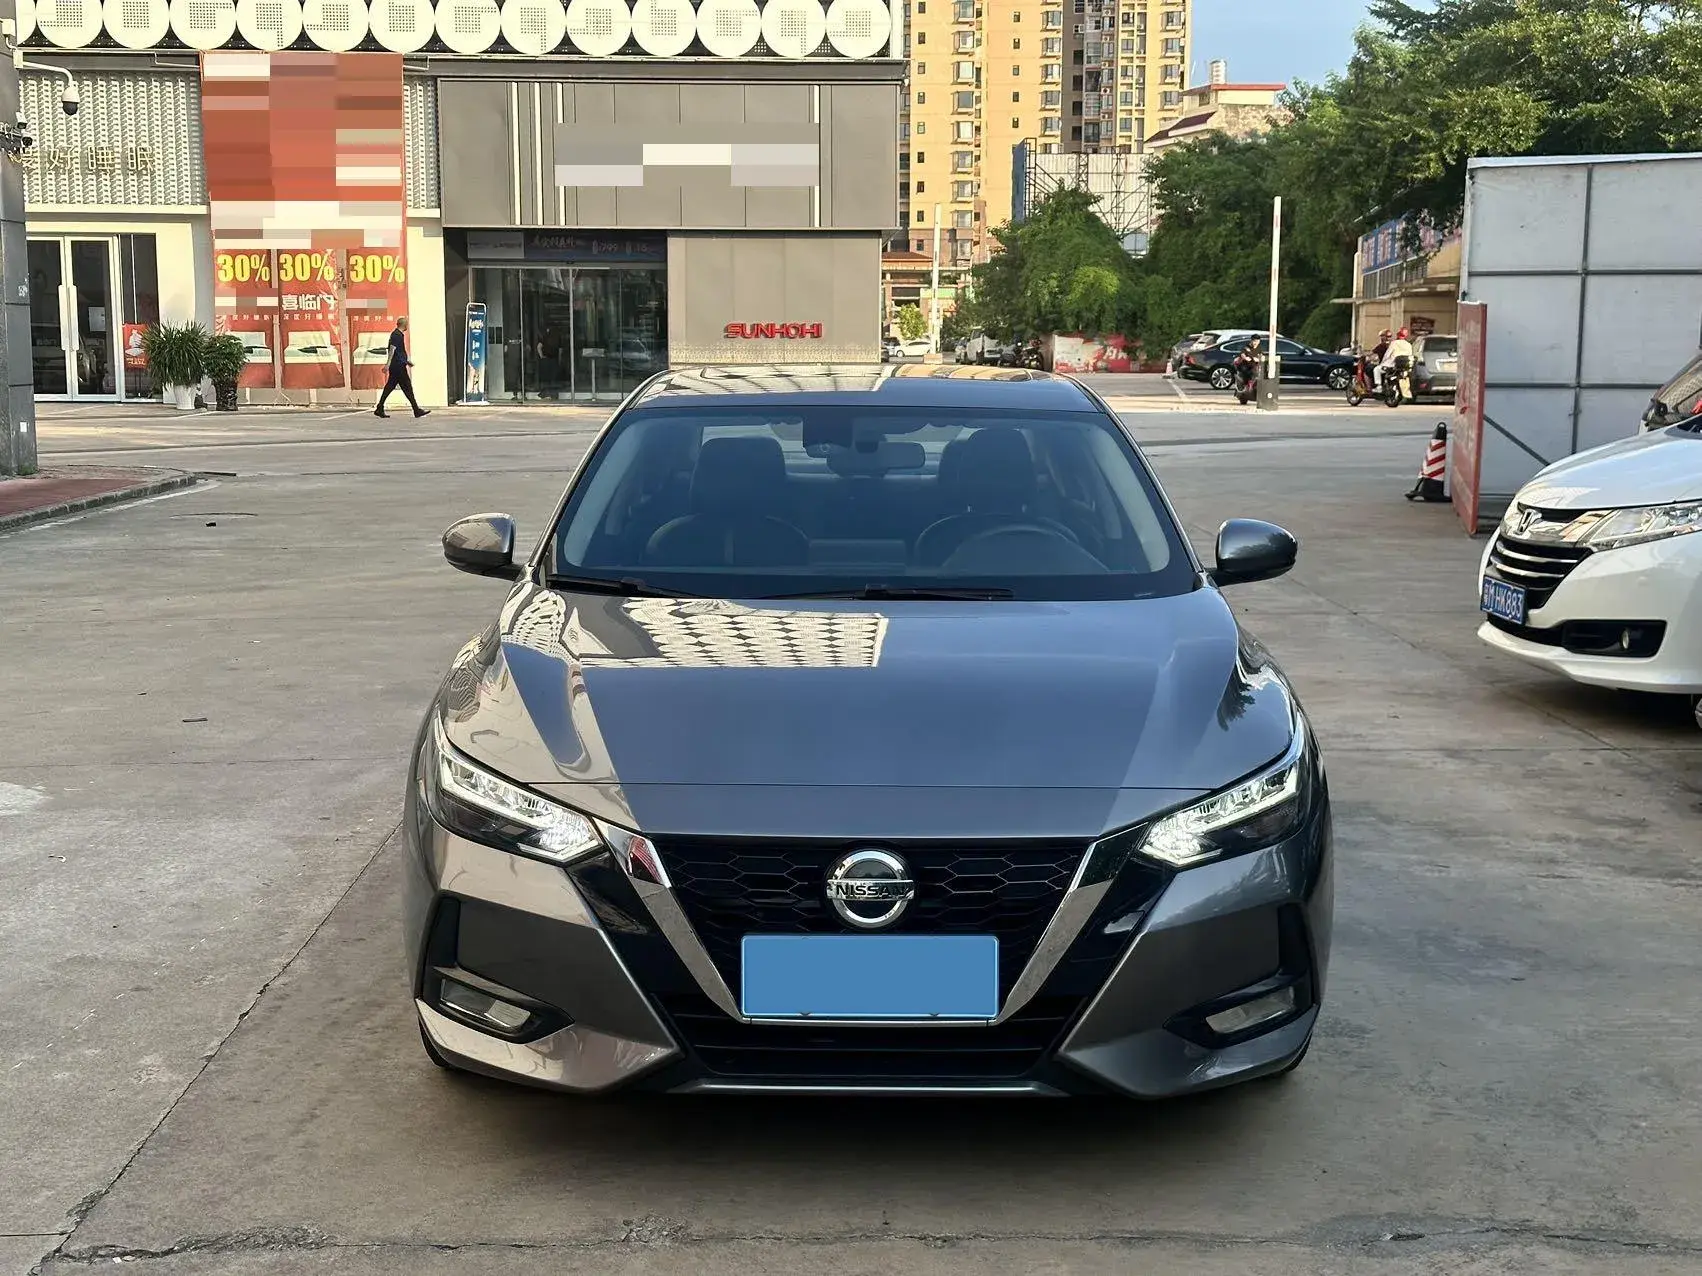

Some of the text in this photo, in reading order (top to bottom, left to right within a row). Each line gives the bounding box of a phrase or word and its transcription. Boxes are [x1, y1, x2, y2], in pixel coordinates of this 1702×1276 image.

[217, 254, 270, 282] 30%
[279, 253, 335, 282] 30%
[350, 254, 406, 283] 30%
[724, 322, 822, 339] SUNHOHI
[836, 884, 906, 897] NISSAN
